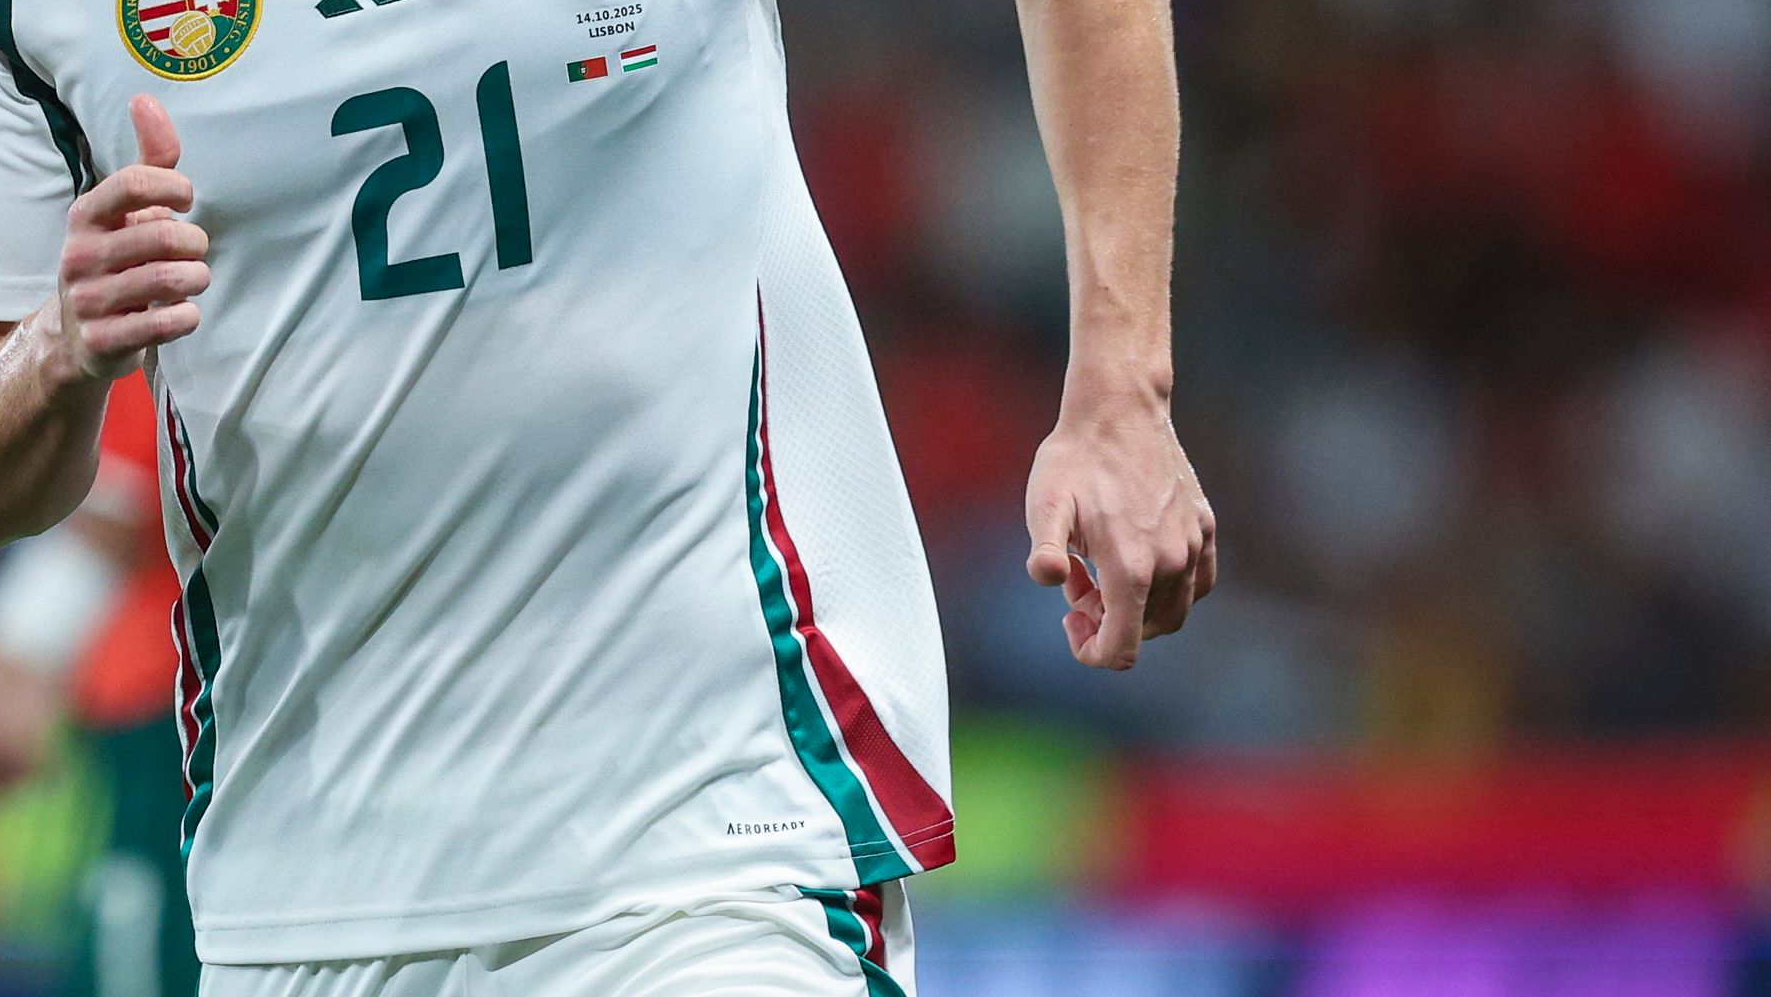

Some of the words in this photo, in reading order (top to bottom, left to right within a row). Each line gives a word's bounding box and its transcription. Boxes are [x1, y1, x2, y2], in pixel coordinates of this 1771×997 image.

[576, 3, 643, 24] 14.10.2025
[588, 21, 635, 38] LISBON
[178, 54, 218, 74] 1901
[330, 60, 533, 302] 21
[727, 820, 805, 835] AEROREADY
